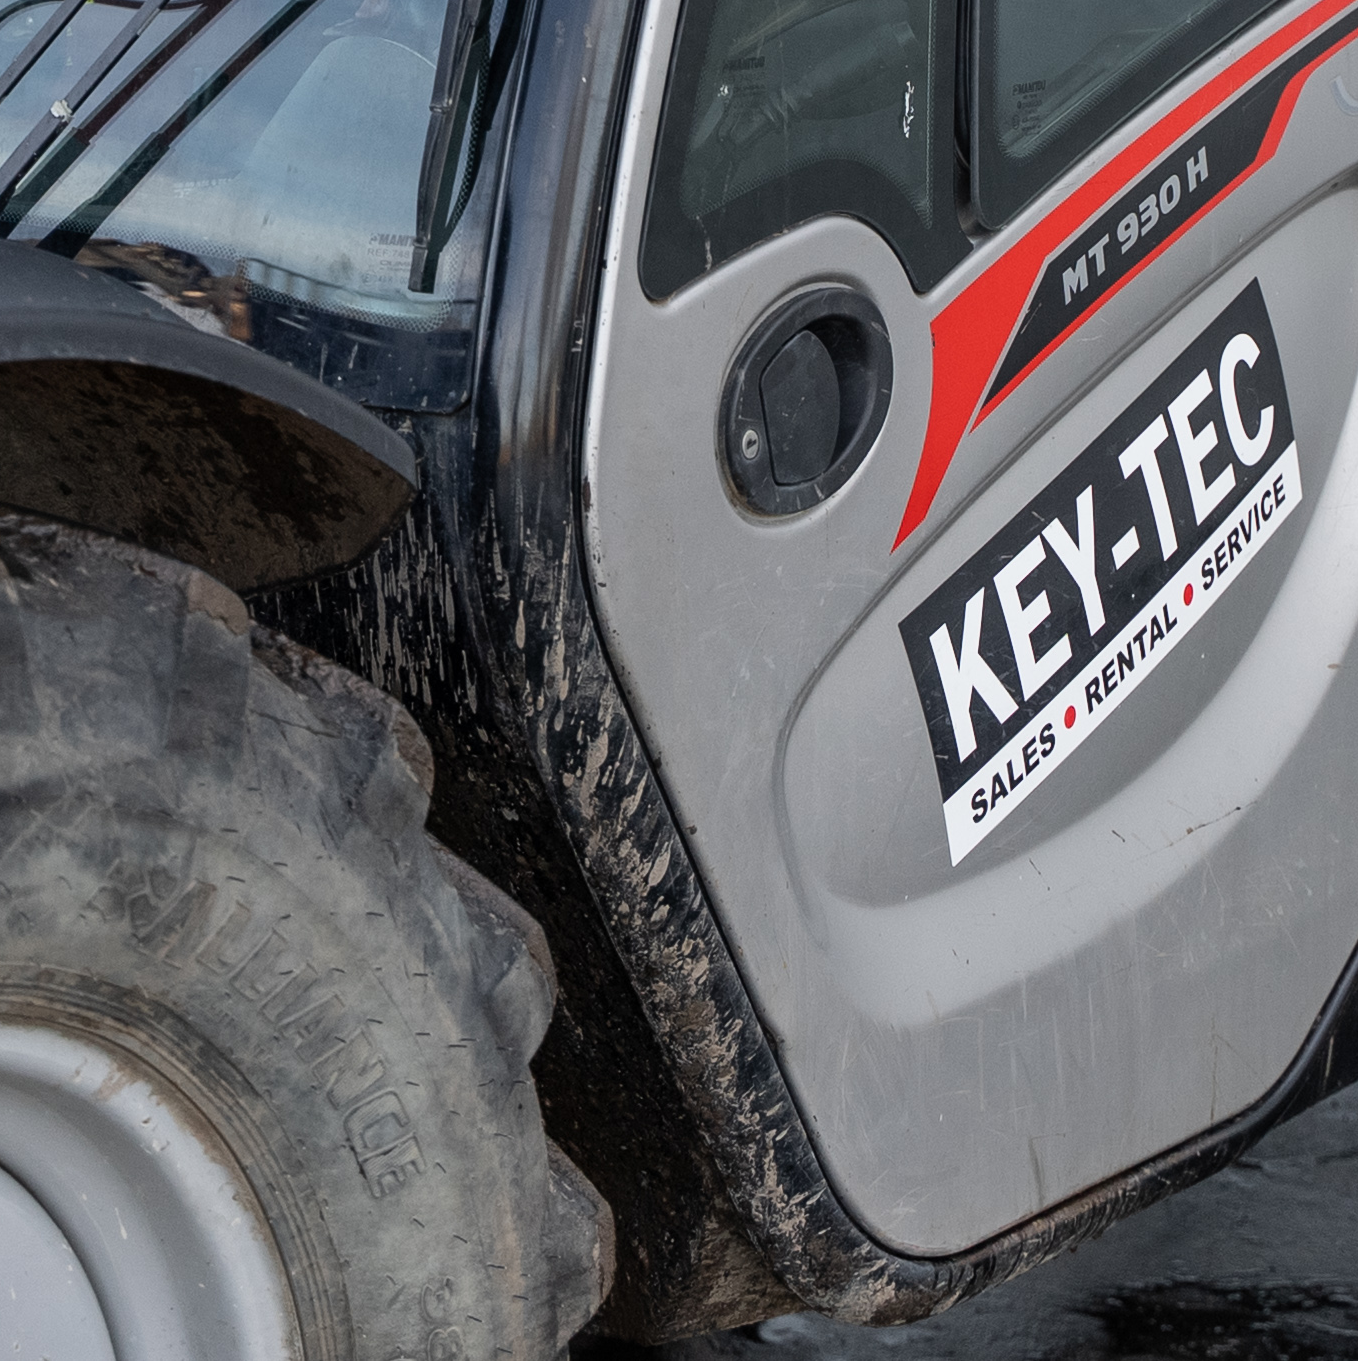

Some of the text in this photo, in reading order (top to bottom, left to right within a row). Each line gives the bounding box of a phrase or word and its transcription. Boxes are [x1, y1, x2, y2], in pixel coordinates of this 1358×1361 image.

[1062, 145, 1209, 306] MT 930 H
[928, 332, 1275, 764] KEY-TEC
[970, 472, 1287, 824] SALES RENTAL SERVICE
[132, 878, 428, 1199] ALLIANCE
